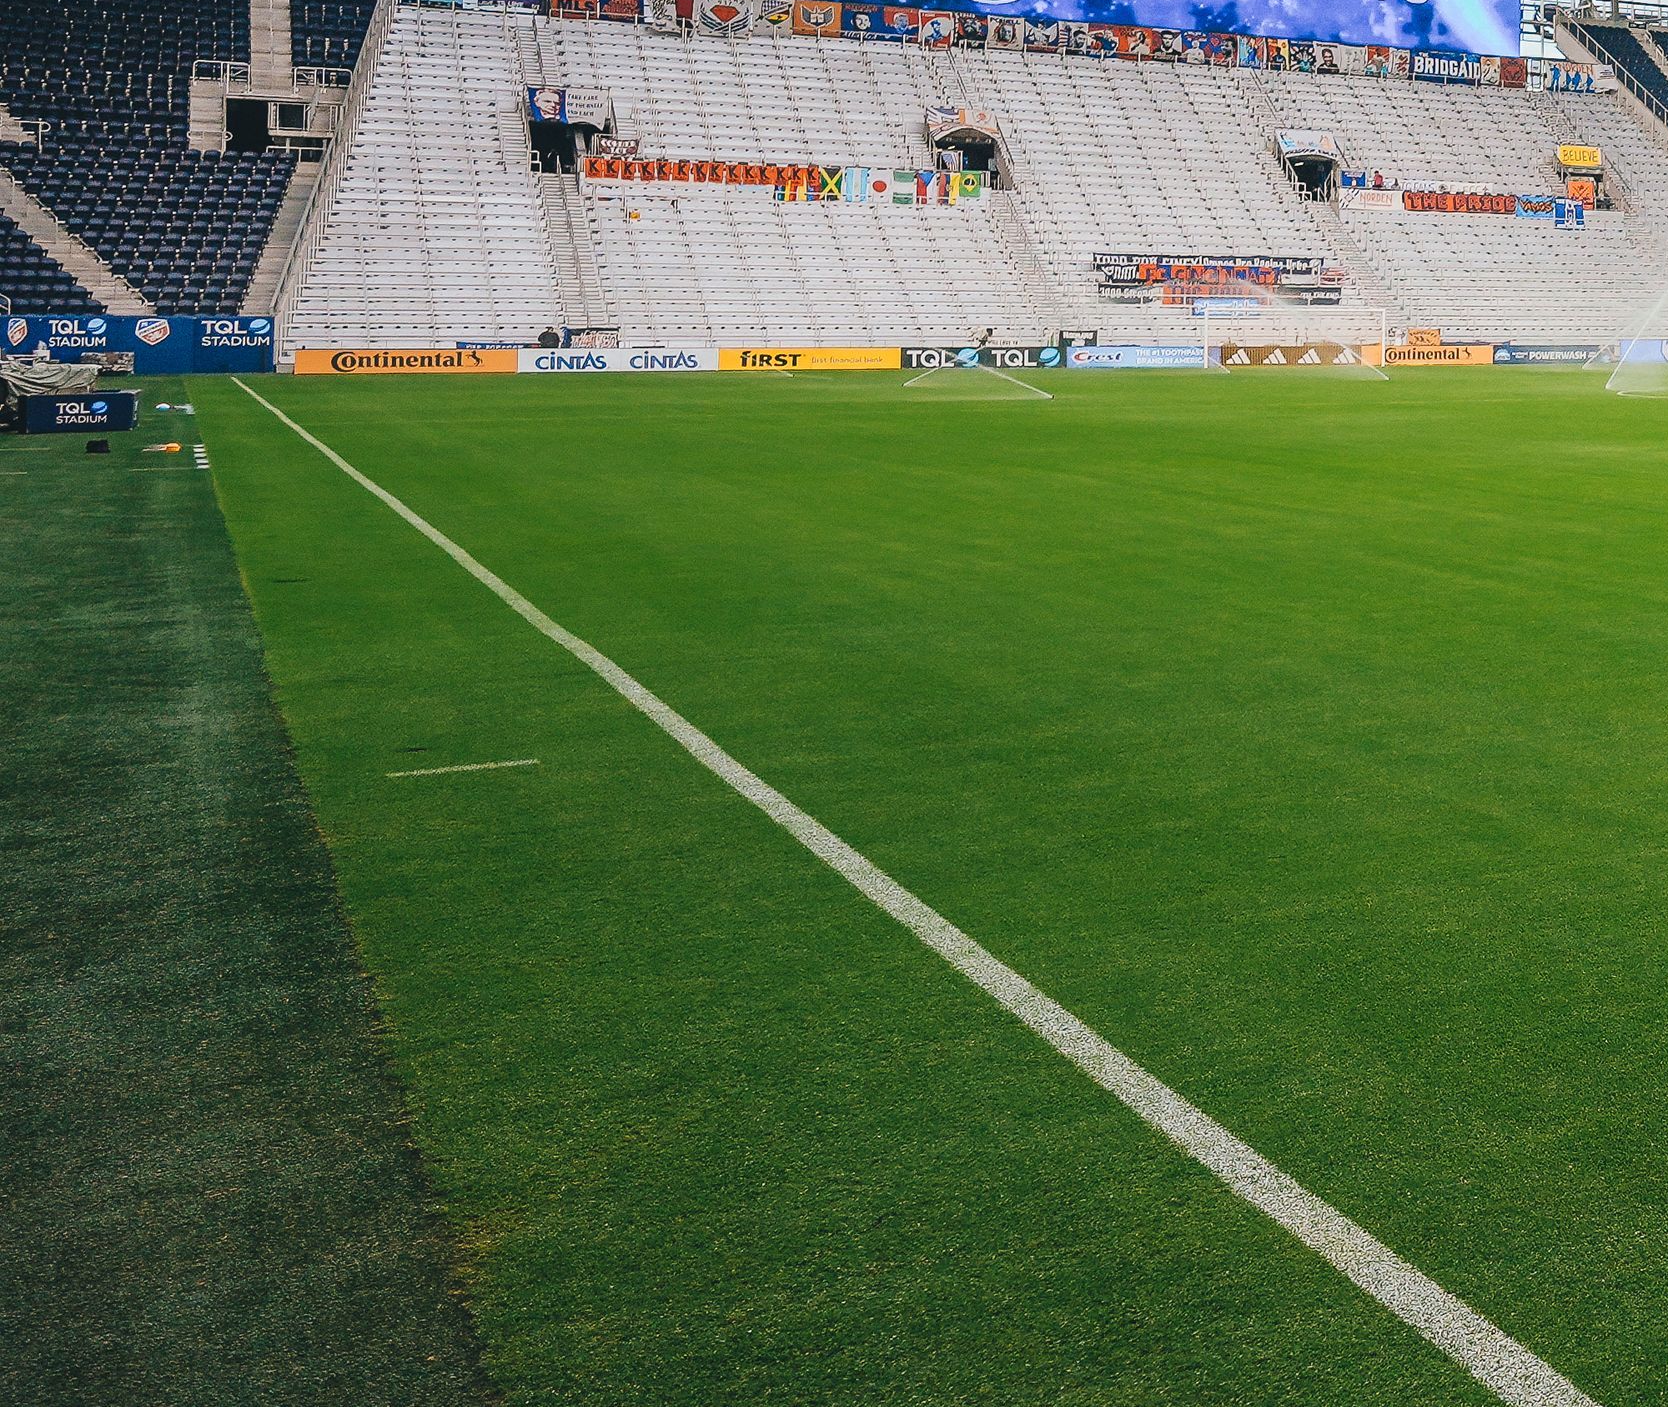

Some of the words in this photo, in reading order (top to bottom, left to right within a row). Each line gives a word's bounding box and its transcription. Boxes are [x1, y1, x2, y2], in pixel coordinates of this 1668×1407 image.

[1360, 193, 1392, 203] NORDEN
[49, 319, 86, 335] TQL
[201, 320, 248, 334] TQL
[49, 336, 106, 347] STADIUM
[201, 336, 270, 346] STADIUM
[907, 349, 955, 368] TQL
[991, 349, 1038, 367] TQL
[1074, 351, 1123, 364] Crest
[1136, 348, 1150, 357] THE
[1161, 348, 1205, 357] TOOTHPAST
[1384, 346, 1462, 361] Continental
[1529, 351, 1587, 361] POWERWASH
[331, 351, 464, 373] Continental
[1136, 356, 1163, 365] BRAND
[1174, 356, 1204, 365] AMERIC
[56, 402, 91, 414] TQL
[56, 415, 107, 424] STADIUM
